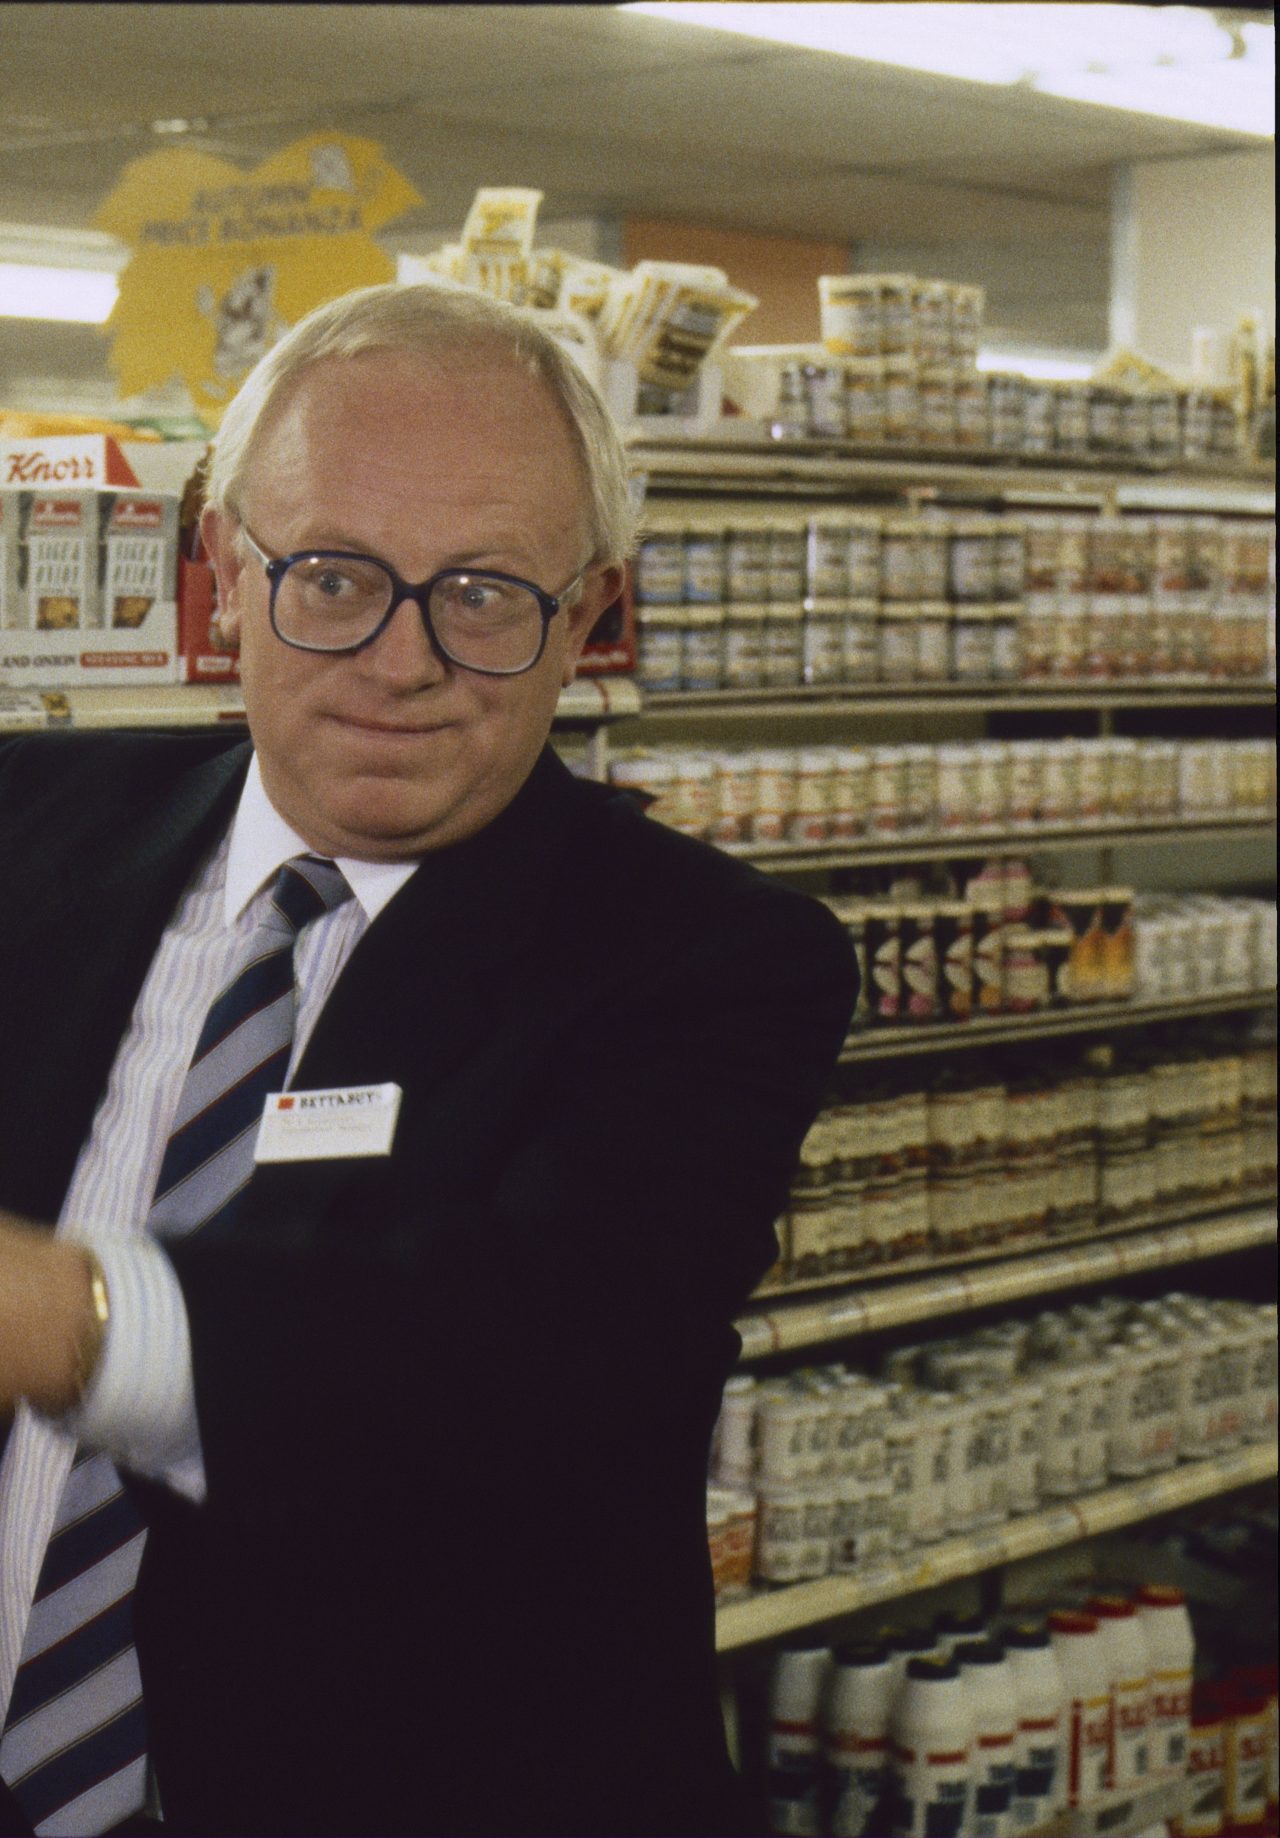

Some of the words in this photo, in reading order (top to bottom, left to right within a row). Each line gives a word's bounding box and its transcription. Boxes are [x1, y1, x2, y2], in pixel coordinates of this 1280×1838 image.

[6, 451, 96, 484] Knorr
[0, 656, 30, 669] AND
[32, 655, 76, 668] ONION
